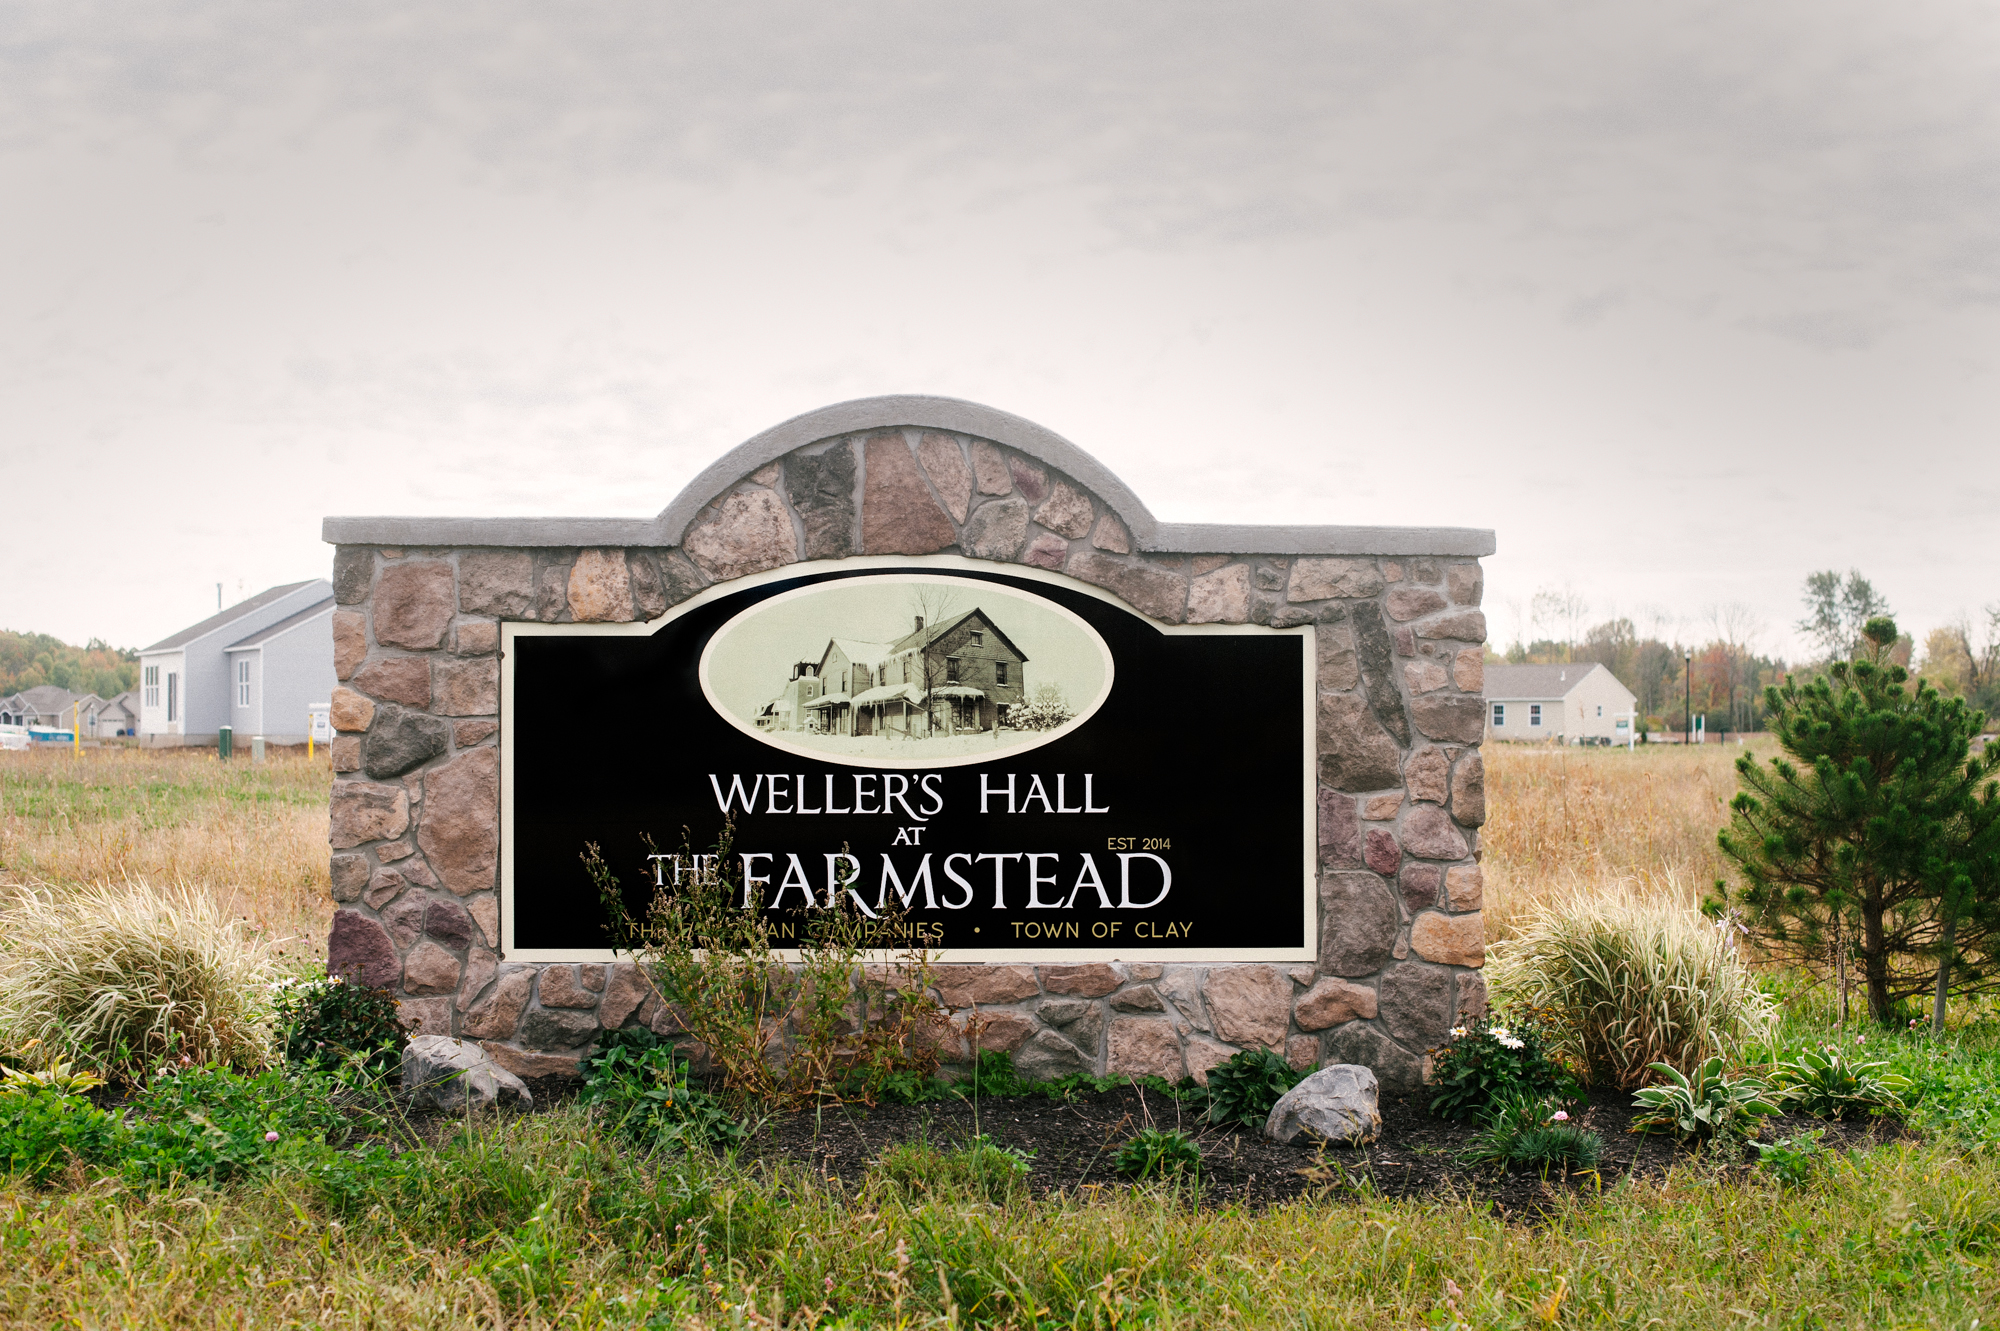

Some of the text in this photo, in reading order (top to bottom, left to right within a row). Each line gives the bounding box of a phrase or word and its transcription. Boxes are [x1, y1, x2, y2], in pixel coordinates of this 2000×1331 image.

[708, 773, 1110, 821] WELLER'S HALL
[891, 826, 926, 846] AT
[1107, 837, 1171, 850] EST 2014
[646, 852, 1172, 919] THE FARMSTEAD
[625, 922, 669, 939] TH
[1011, 922, 1079, 939] TOWN
[1092, 922, 1122, 939] OF
[1135, 922, 1193, 939] CLAY
